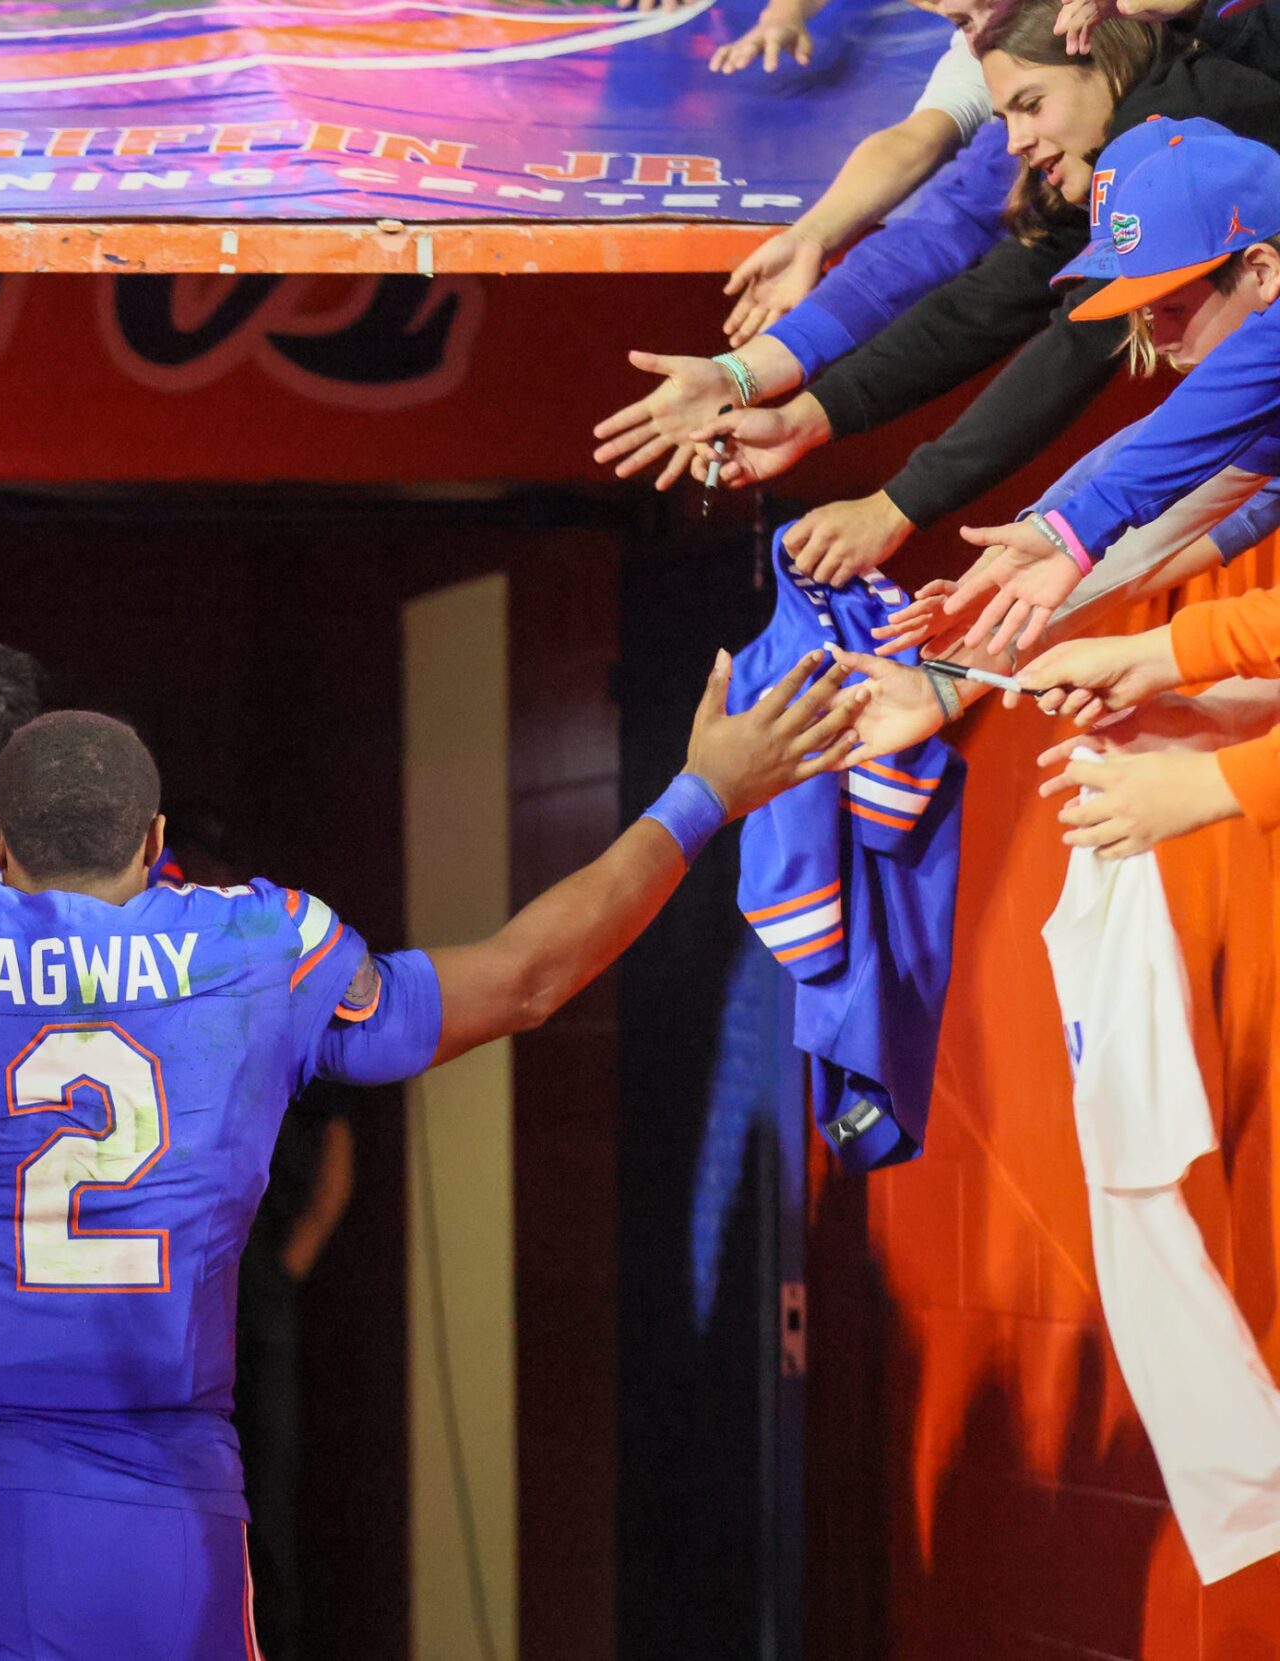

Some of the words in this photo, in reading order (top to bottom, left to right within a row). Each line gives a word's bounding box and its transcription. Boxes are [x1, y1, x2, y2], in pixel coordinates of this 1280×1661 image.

[336, 167, 803, 208] CENTER
[524, 150, 747, 187] JR.
[1091, 168, 1116, 227] F
[6, 1021, 170, 1293] 2
